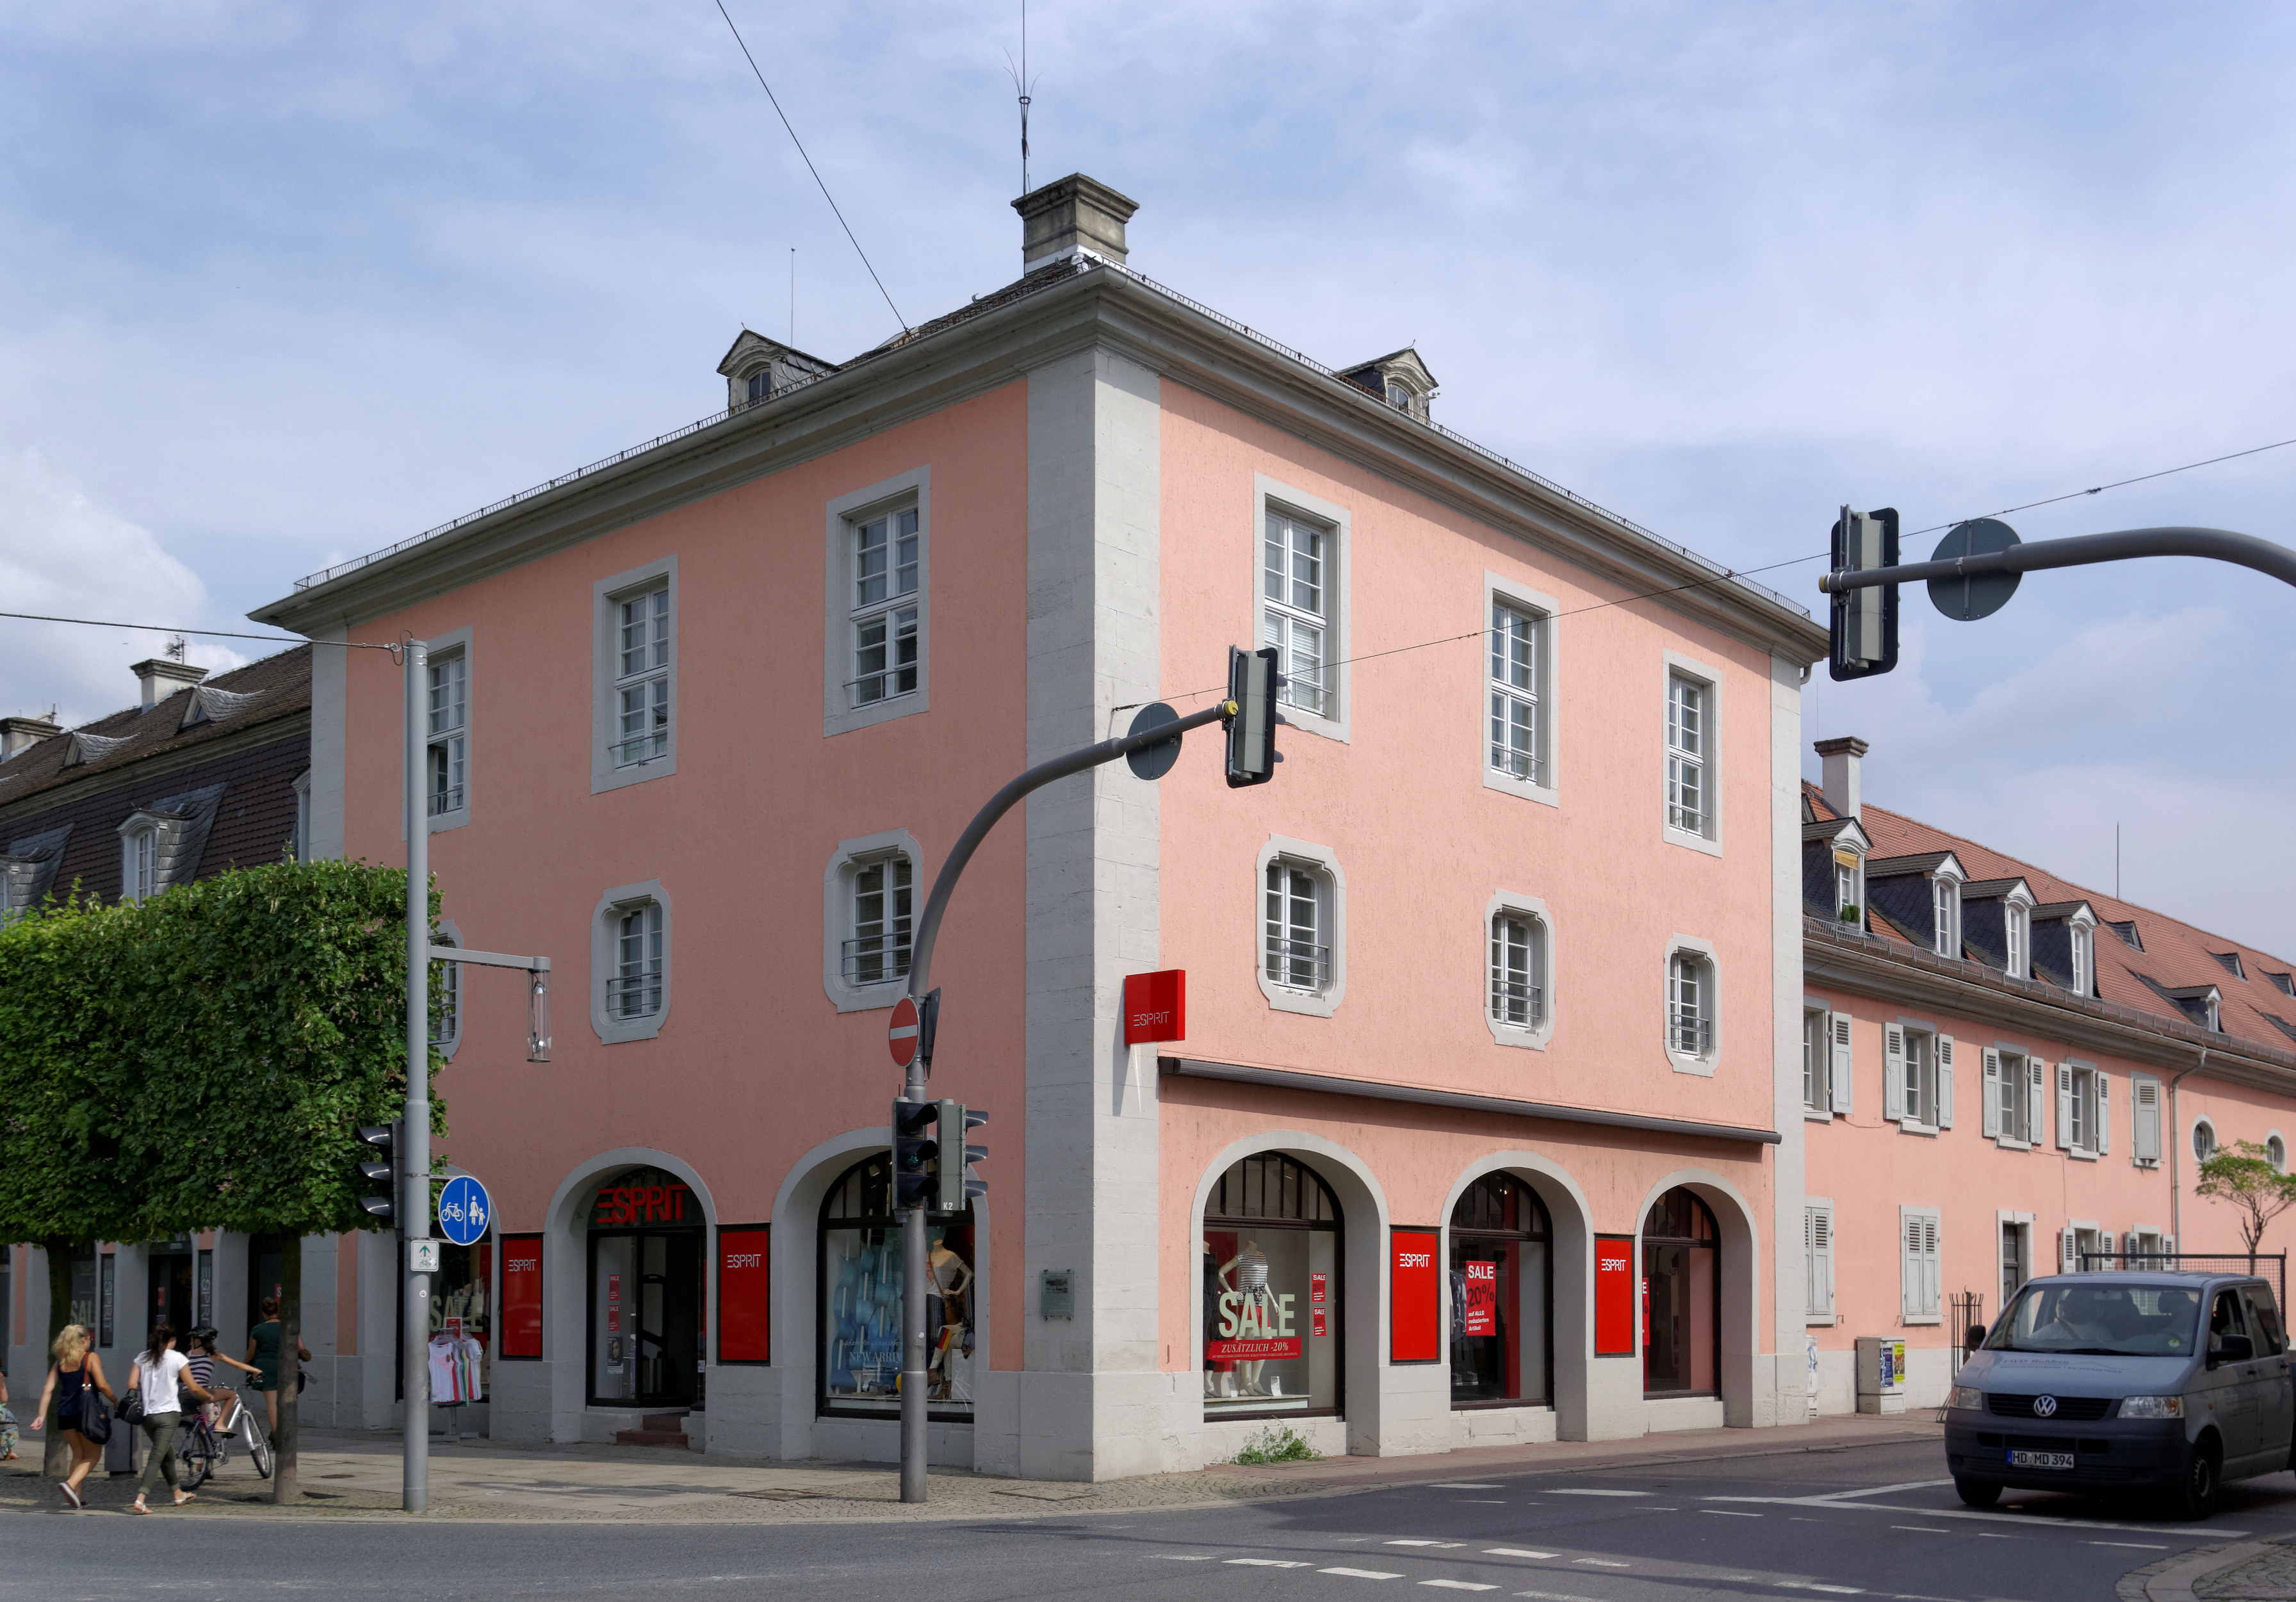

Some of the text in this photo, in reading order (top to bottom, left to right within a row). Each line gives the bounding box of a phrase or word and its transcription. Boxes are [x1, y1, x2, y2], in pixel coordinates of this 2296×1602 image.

[1133, 1011, 1170, 1027] ESPRIT
[597, 1184, 690, 1223] ESPRIT
[943, 1202, 954, 1211] K2
[508, 1259, 537, 1272] ESPRIT
[727, 1254, 761, 1268] ESPRIT
[1399, 1253, 1431, 1268] ESPRIT
[1601, 1258, 1627, 1271] ESPRIT
[1468, 1264, 1494, 1279] SALE
[200, 1266, 211, 1327] ESPRI
[1467, 1282, 1495, 1308] 20%
[71, 1300, 95, 1329] SAL
[1218, 1292, 1296, 1337] SALE
[1221, 1341, 1289, 1353] ZUSÄTZLICH -20%
[849, 1352, 903, 1362] NEW ARRIV
[2013, 1452, 2028, 1464] HD
[2034, 1453, 2049, 1466] MD
[2051, 1454, 2072, 1467] 394
